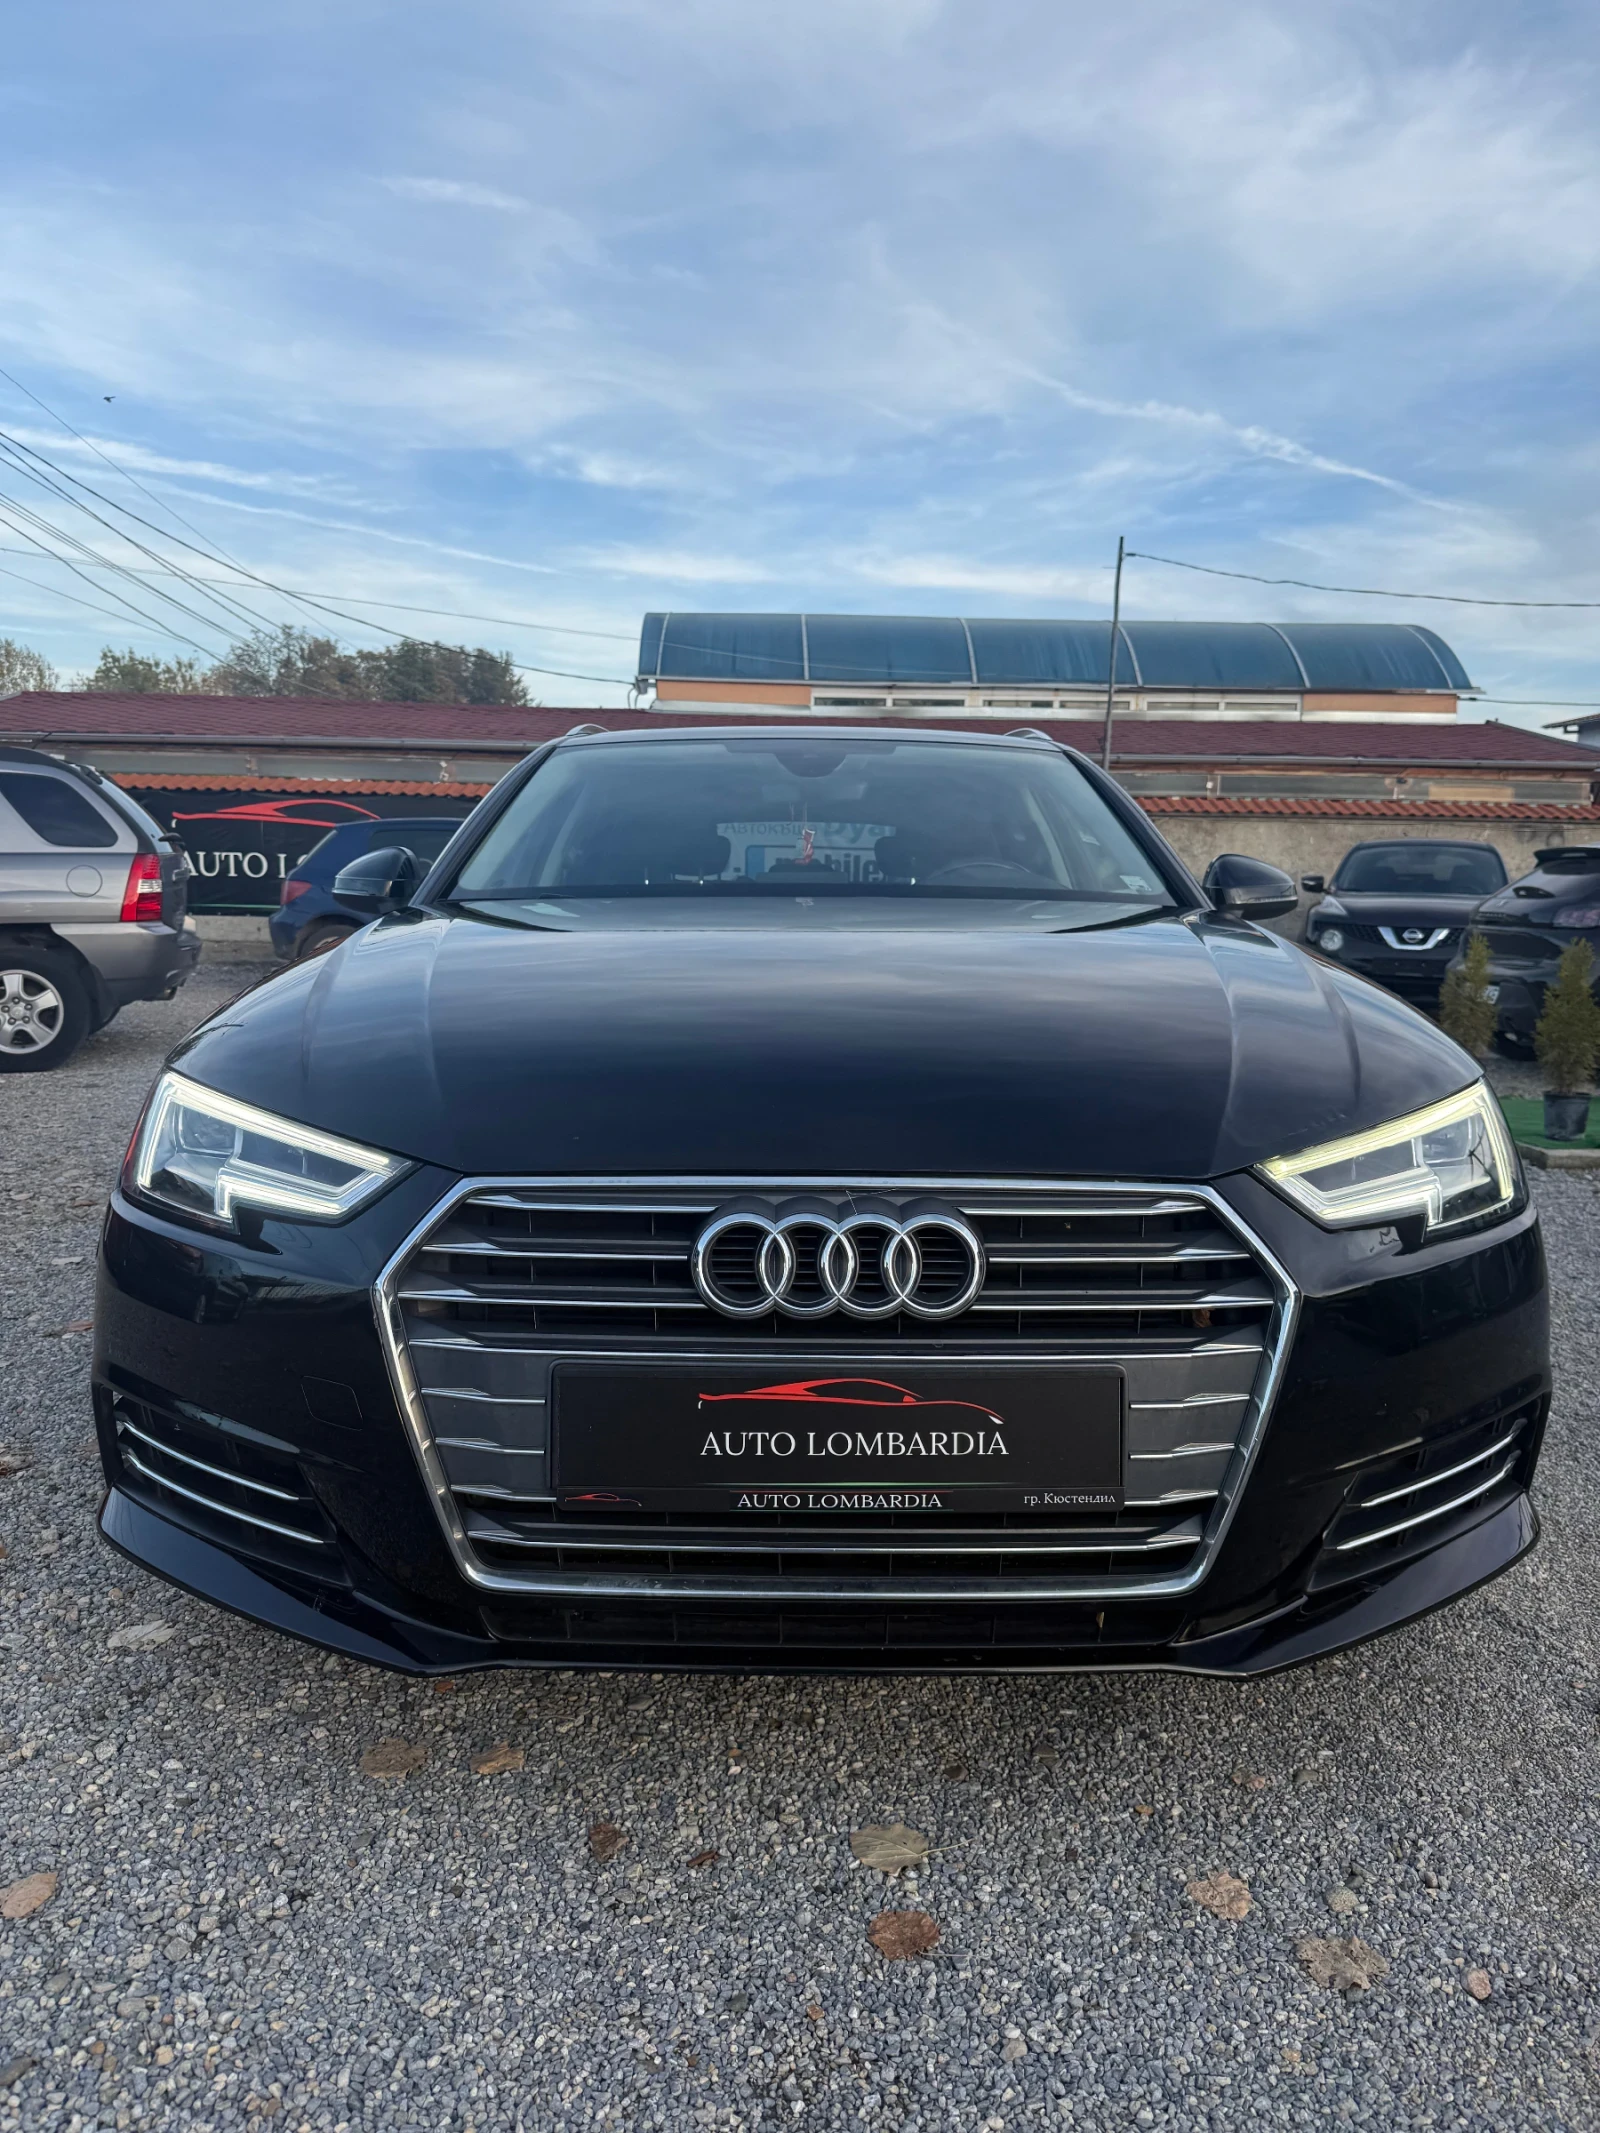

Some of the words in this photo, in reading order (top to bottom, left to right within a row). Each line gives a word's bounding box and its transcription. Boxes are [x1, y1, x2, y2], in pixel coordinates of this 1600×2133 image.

[700, 1431, 796, 1456] AUTO
[807, 1431, 1009, 1456] LOMBARDIA
[737, 1494, 801, 1508] AUTO
[807, 1494, 943, 1508] LOMBARDIA
[1023, 1494, 1041, 1506] гр.
[1043, 1492, 1116, 1504] Кюстендил
